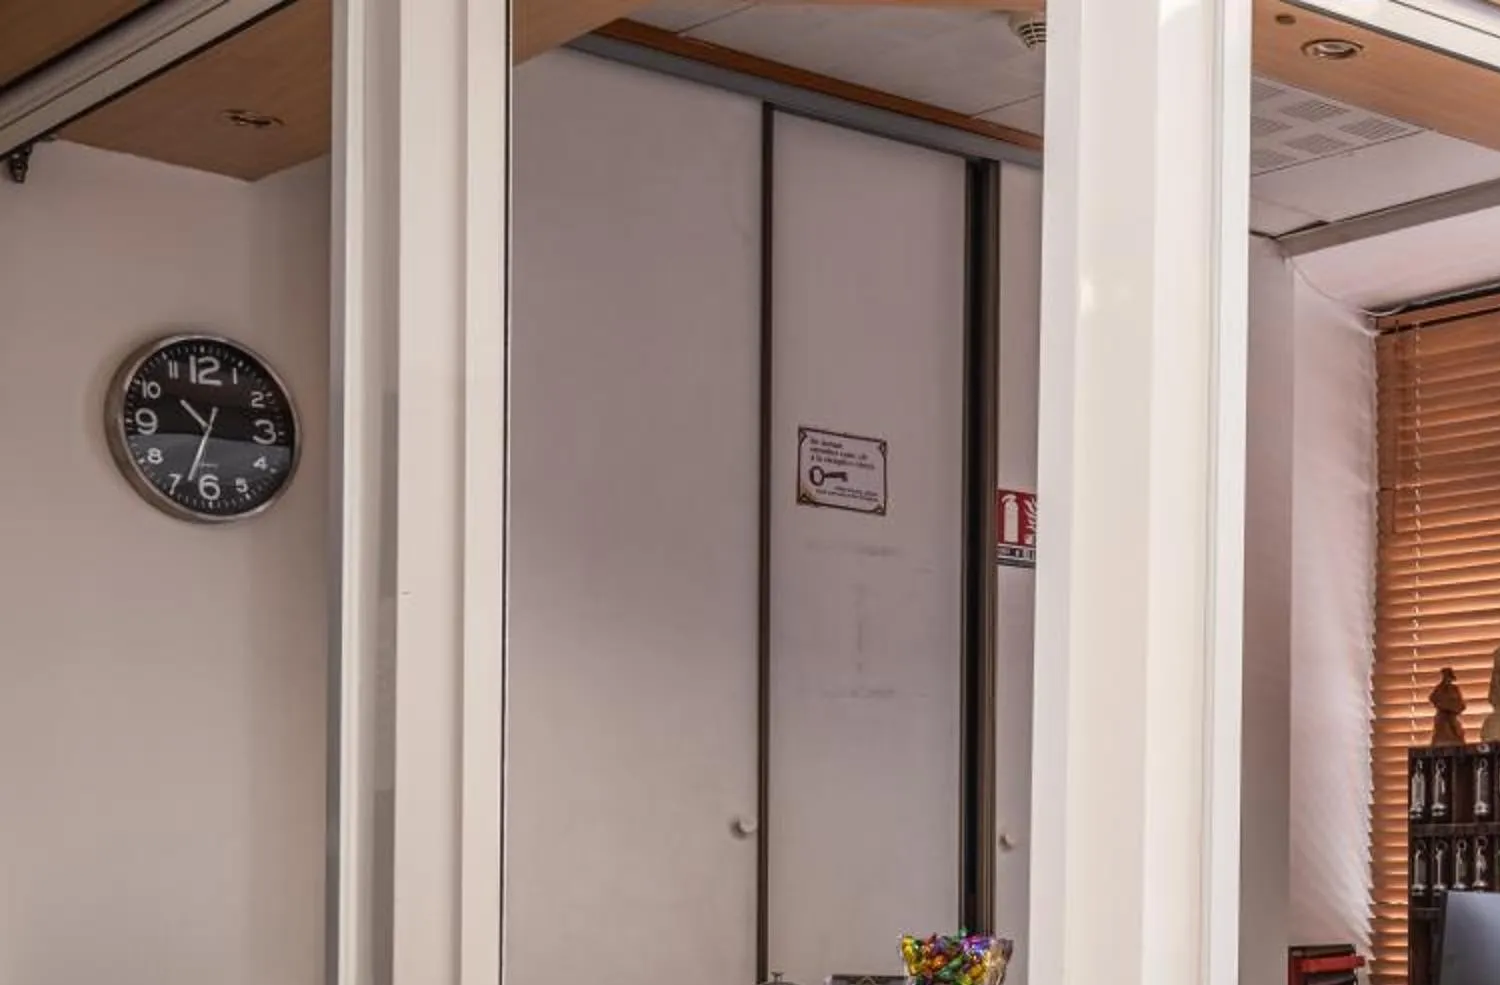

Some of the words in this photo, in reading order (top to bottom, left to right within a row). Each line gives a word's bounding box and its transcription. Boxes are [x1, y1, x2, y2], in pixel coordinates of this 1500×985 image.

[168, 359, 179, 379] 11
[188, 355, 222, 386] 12
[232, 366, 238, 385] 1
[142, 381, 161, 399] 10
[250, 391, 265, 408] 2
[135, 408, 158, 435] 9
[253, 419, 276, 445] 3
[147, 448, 163, 464] 8
[253, 456, 268, 470] 4
[168, 473, 183, 495] 7
[198, 474, 221, 500] 6
[235, 477, 249, 493] 5
